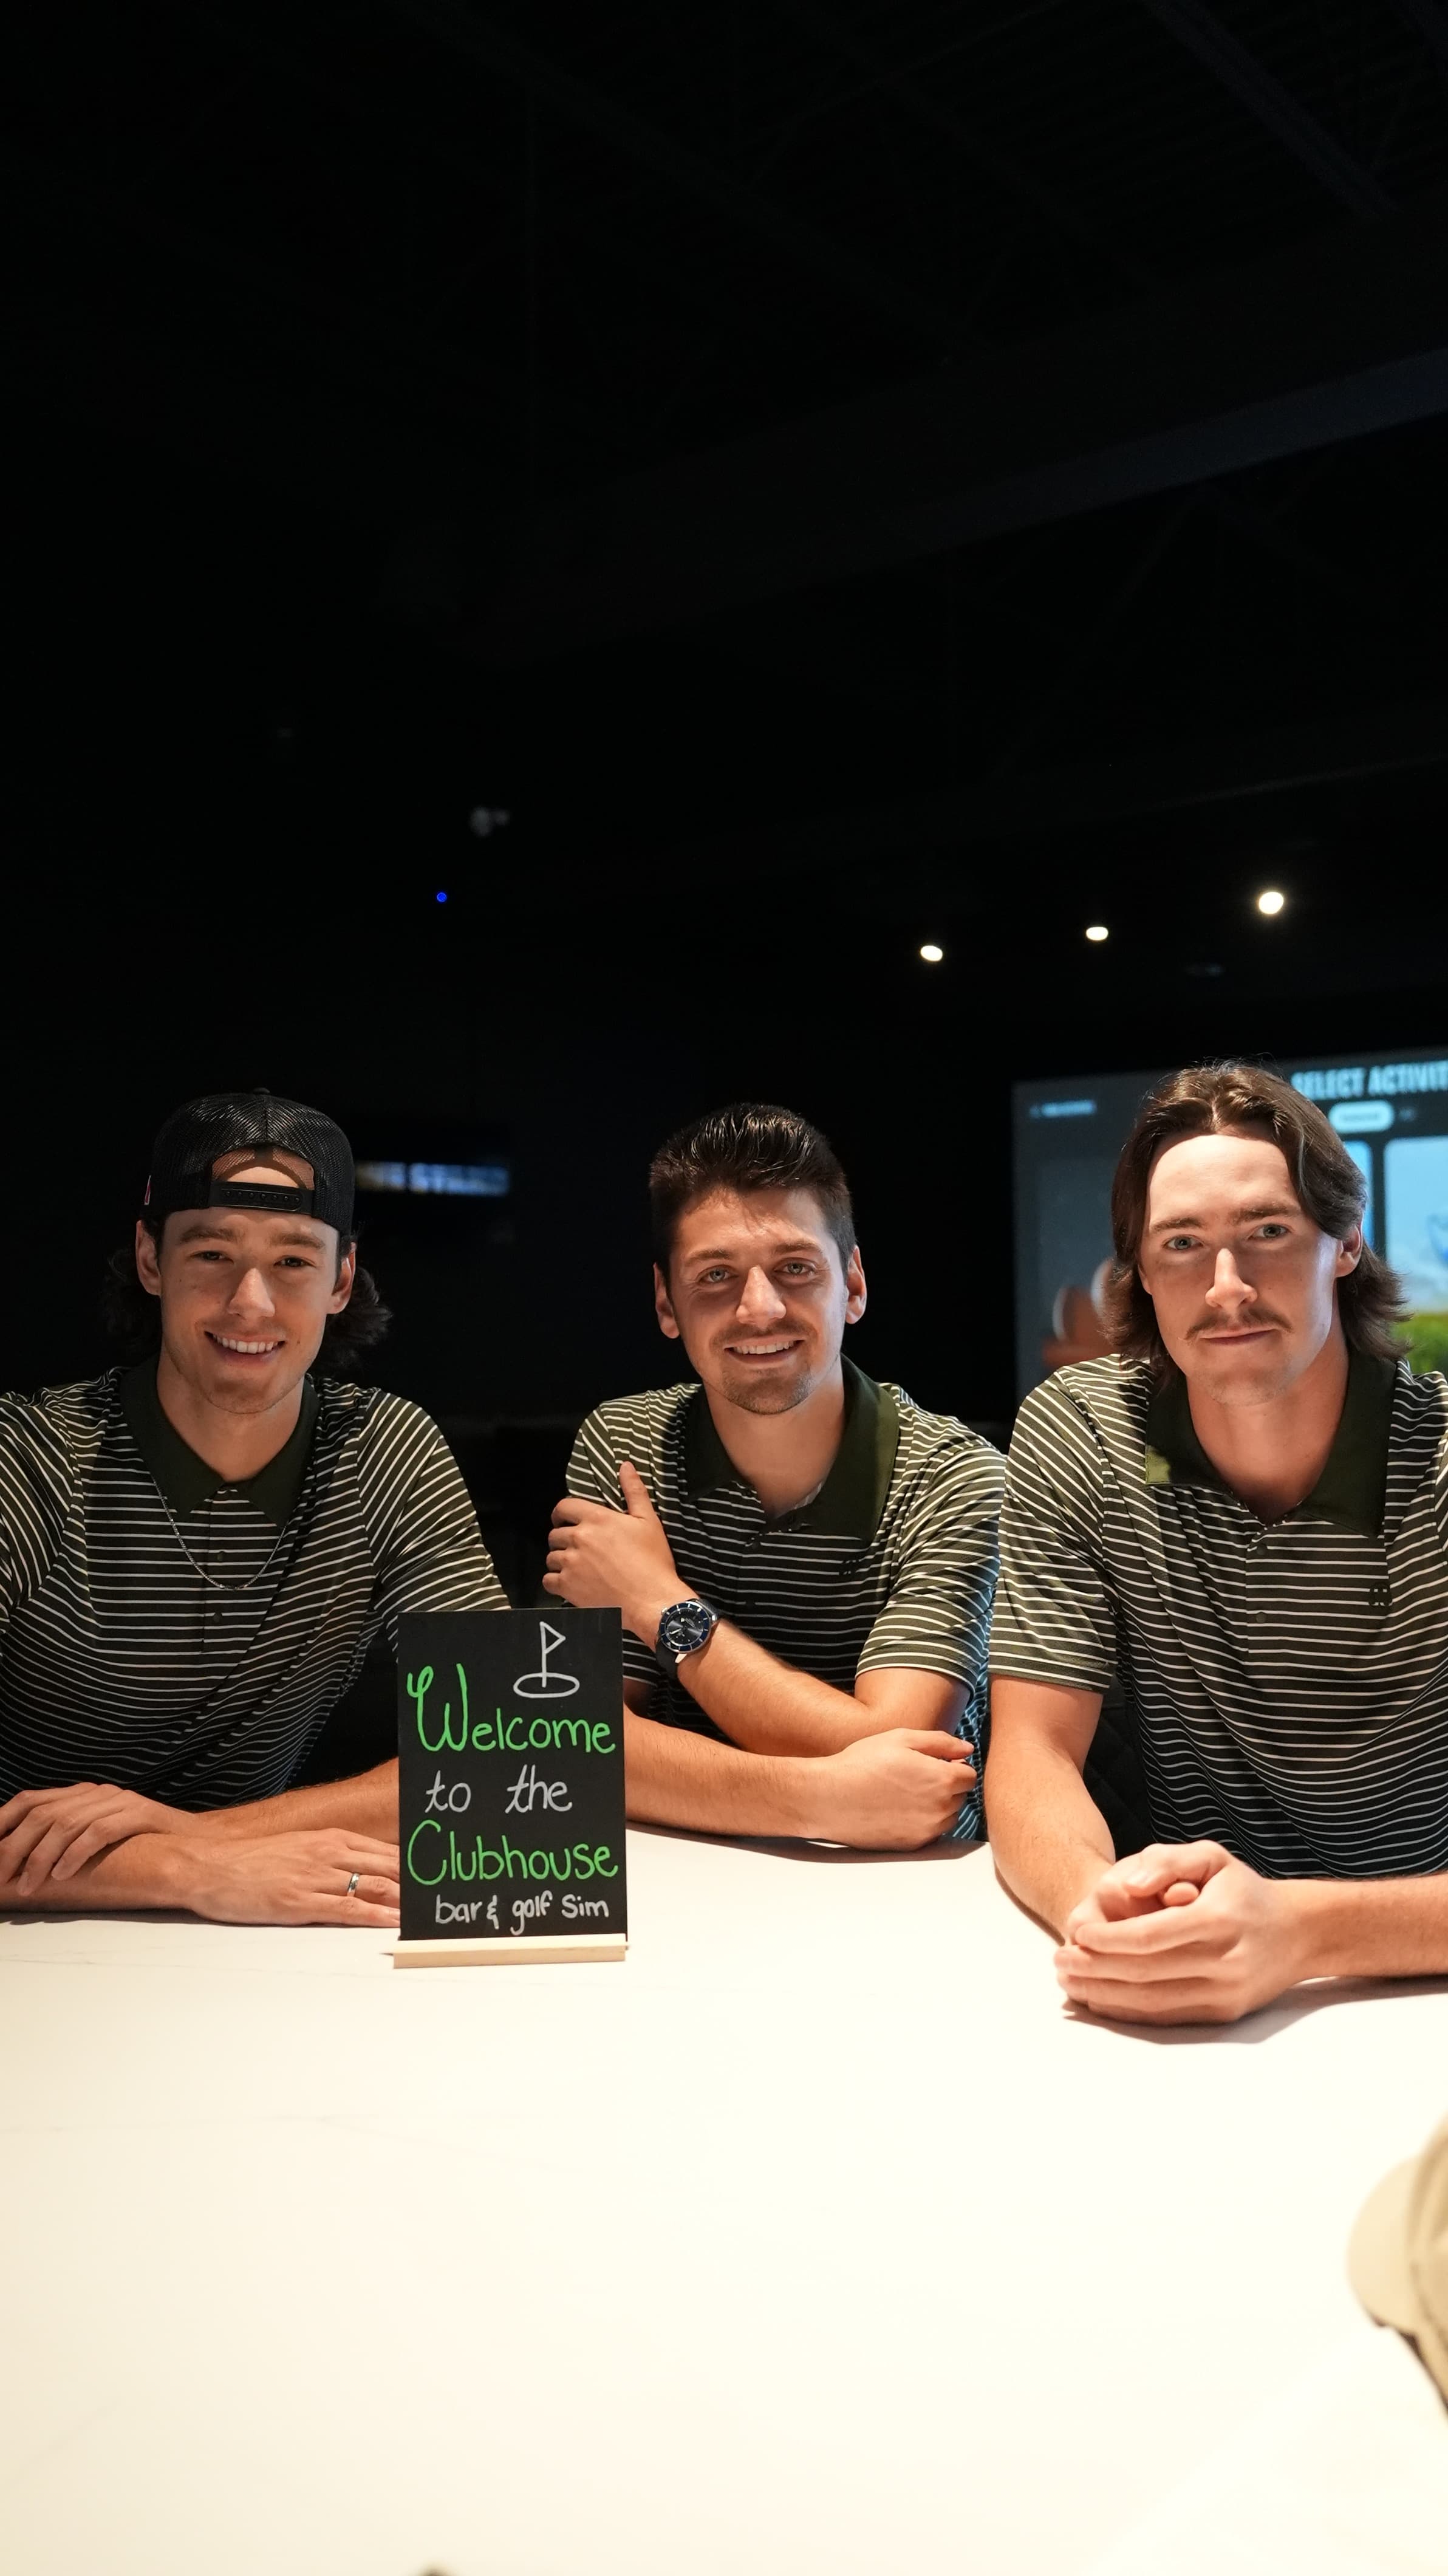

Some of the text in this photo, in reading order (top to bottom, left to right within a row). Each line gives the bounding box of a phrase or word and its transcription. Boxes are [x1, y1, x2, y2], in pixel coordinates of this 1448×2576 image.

[1291, 1067, 1365, 1100] SELECT
[407, 1663, 616, 1753] Welcome
[425, 1764, 573, 1813] to the
[408, 1820, 618, 1885] Clubhouse
[510, 1889, 553, 1936] golf
